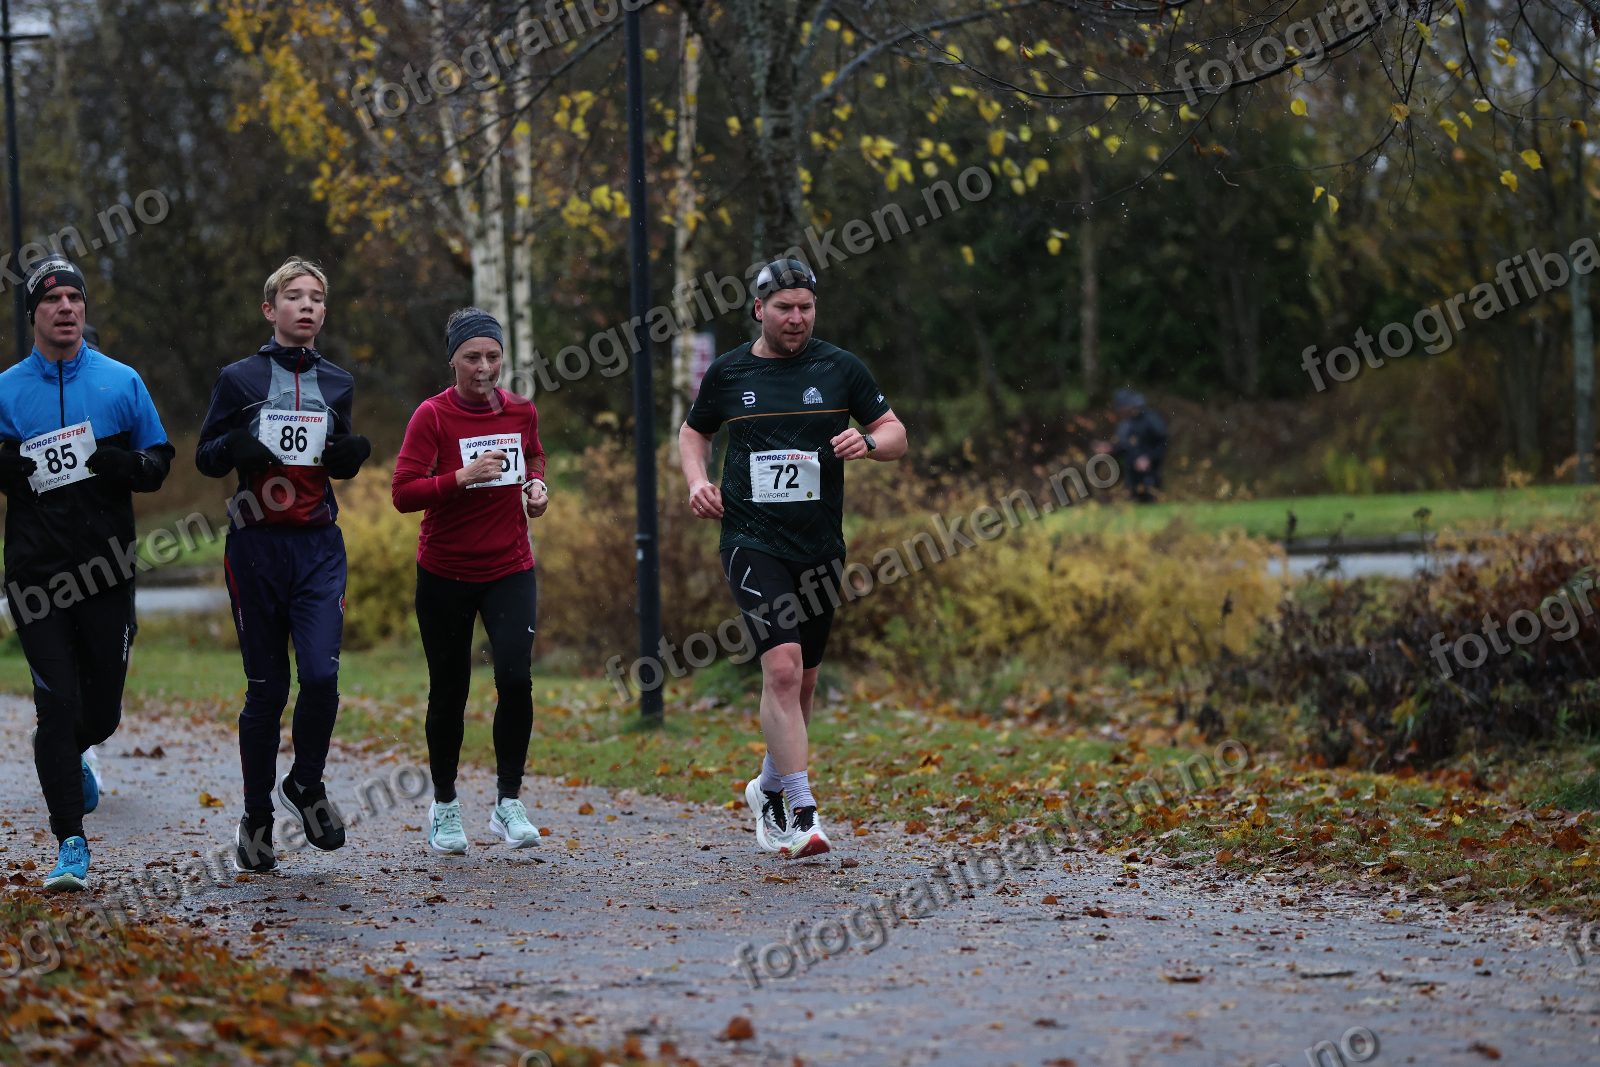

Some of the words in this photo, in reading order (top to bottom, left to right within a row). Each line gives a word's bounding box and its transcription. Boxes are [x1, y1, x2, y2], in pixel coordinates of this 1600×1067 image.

[266, 414, 323, 423] NORGESTESTEN
[25, 426, 87, 452] NORGESTESTEN
[280, 425, 308, 452] 86
[466, 438, 517, 448] NORGESTESTEN
[45, 443, 78, 474] 85
[770, 463, 800, 490] 72
